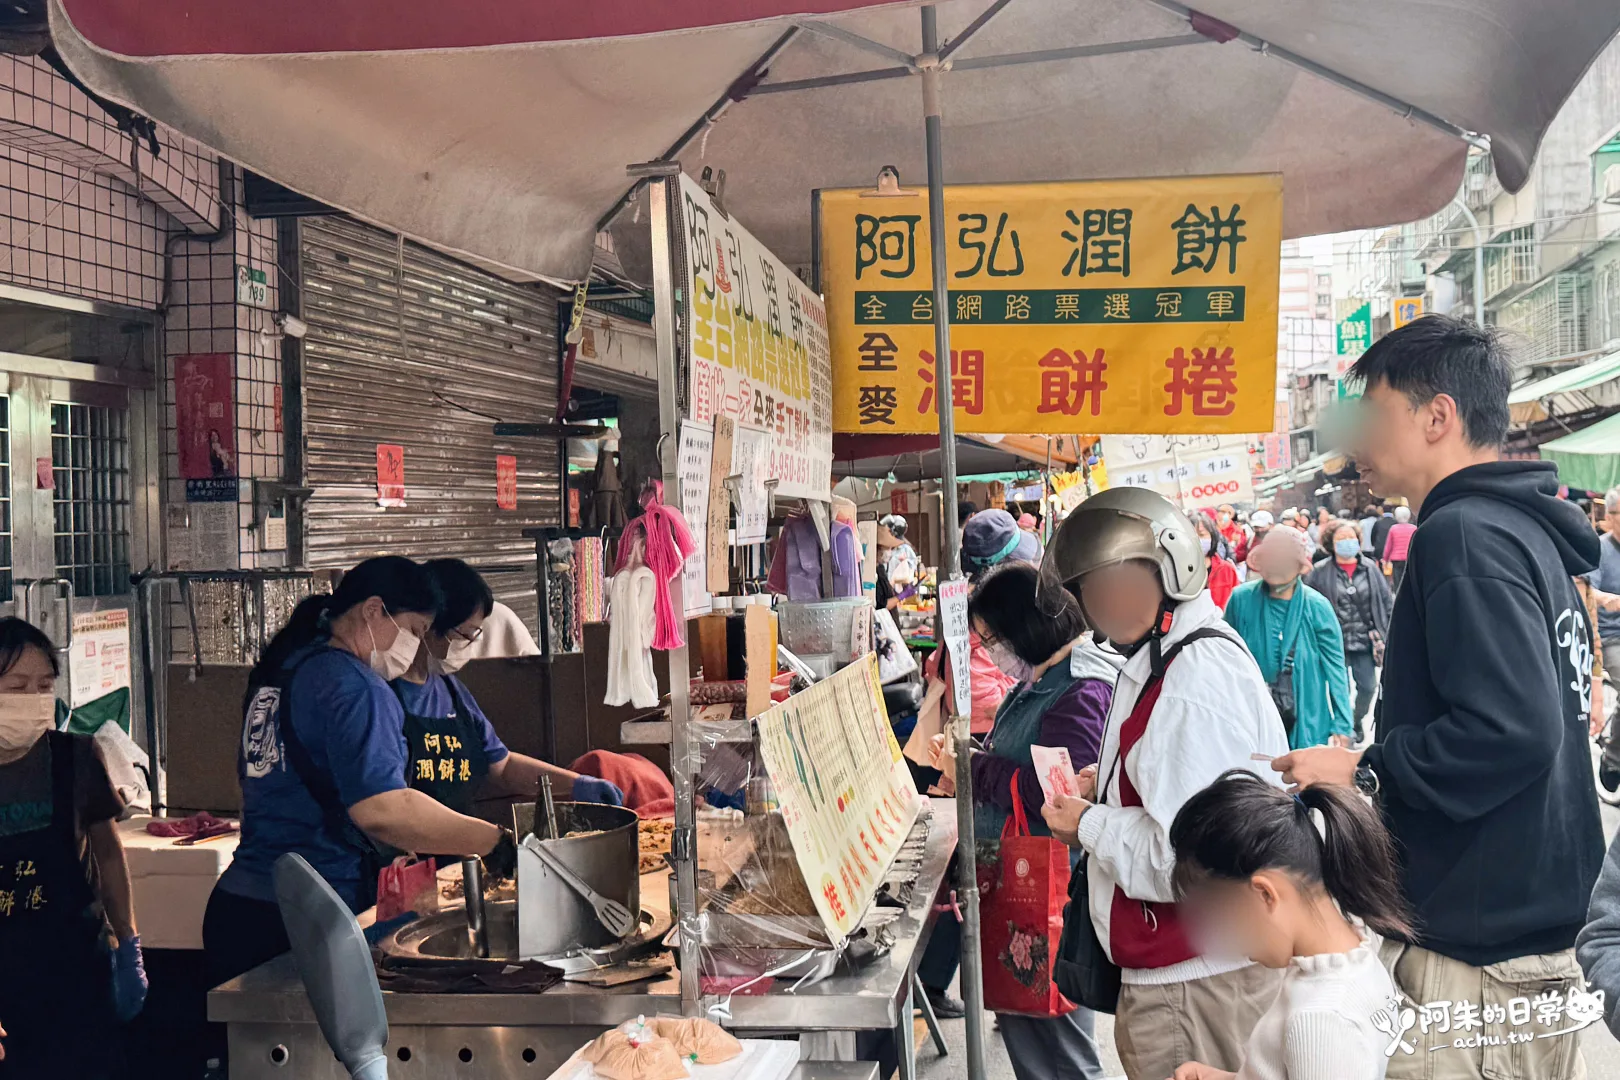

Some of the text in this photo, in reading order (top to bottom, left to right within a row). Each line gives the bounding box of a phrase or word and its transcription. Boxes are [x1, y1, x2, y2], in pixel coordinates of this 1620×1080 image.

[854, 203, 1247, 280] 阿弘潤餅
[861, 291, 1235, 321] 全台網路票選冠軍
[858, 332, 898, 425] 全麥
[918, 347, 1238, 417] 潤餅捲
[424, 732, 462, 755] 阿弘
[416, 758, 472, 783] 潤餅捲
